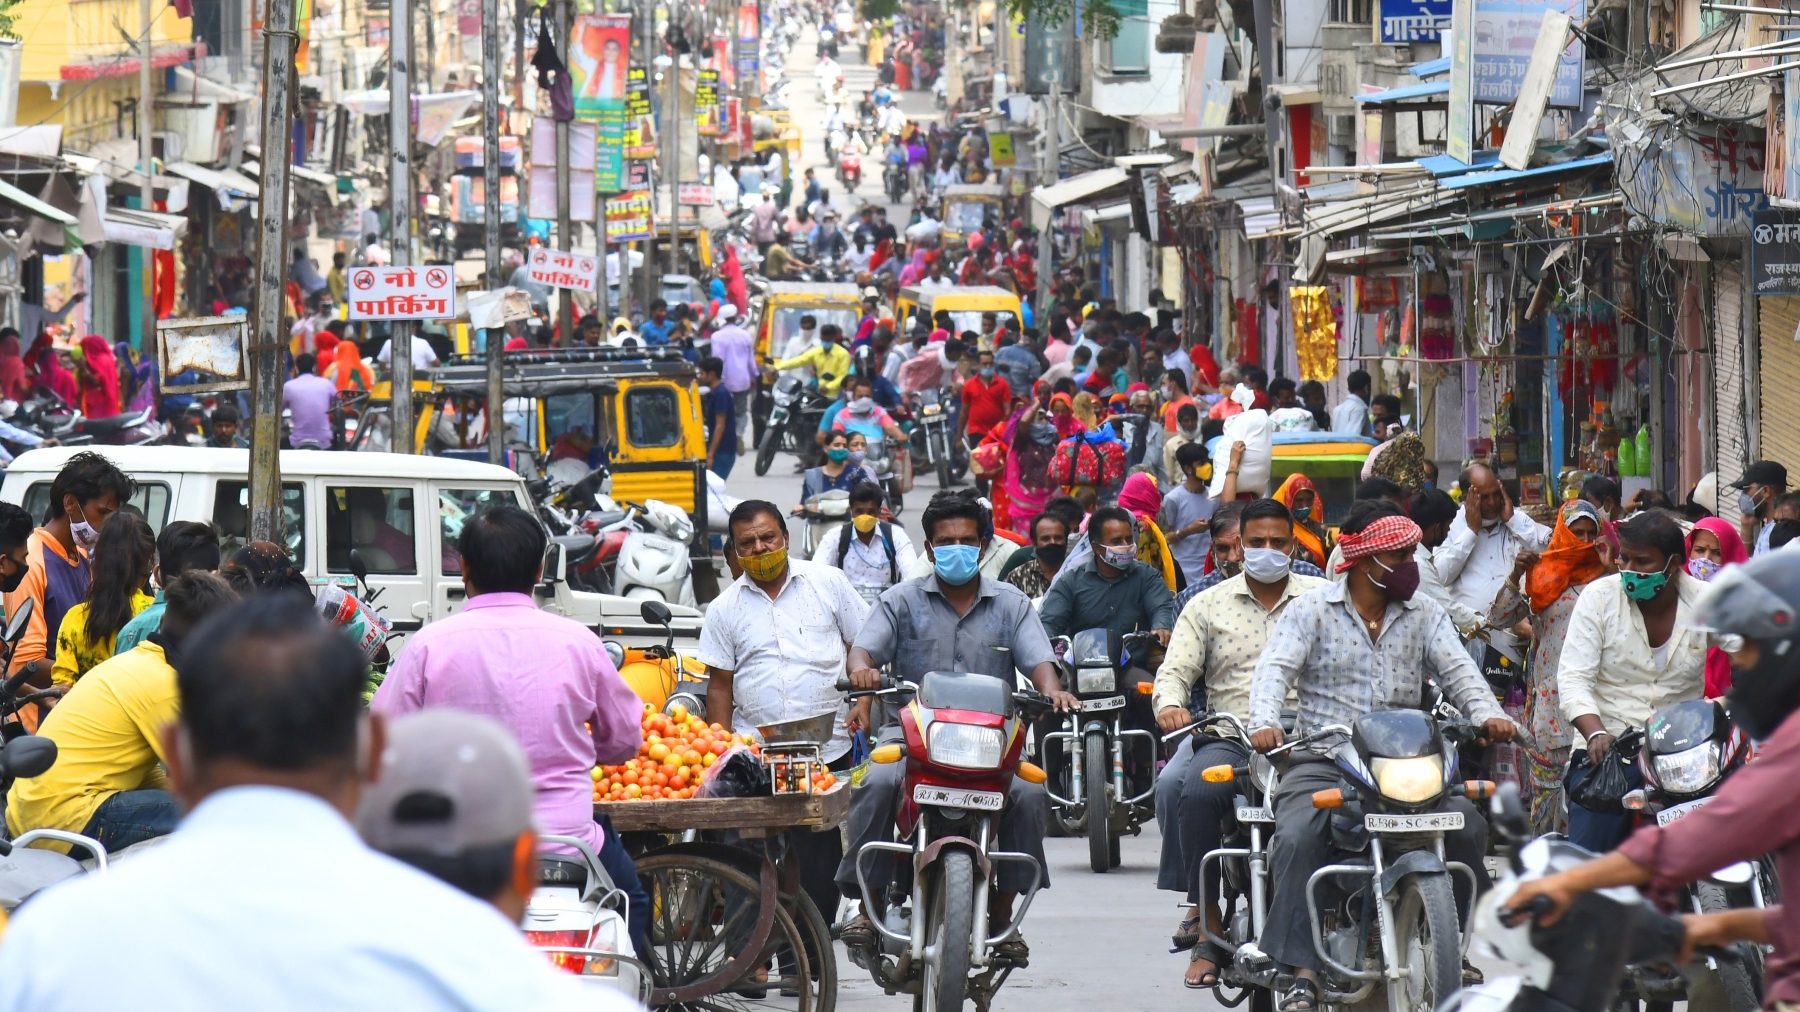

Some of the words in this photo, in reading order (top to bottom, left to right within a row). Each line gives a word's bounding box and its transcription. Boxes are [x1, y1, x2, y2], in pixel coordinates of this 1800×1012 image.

[383, 267, 417, 288] नो
[532, 270, 590, 289] पार्किंग
[355, 294, 447, 315] पार्किंग
